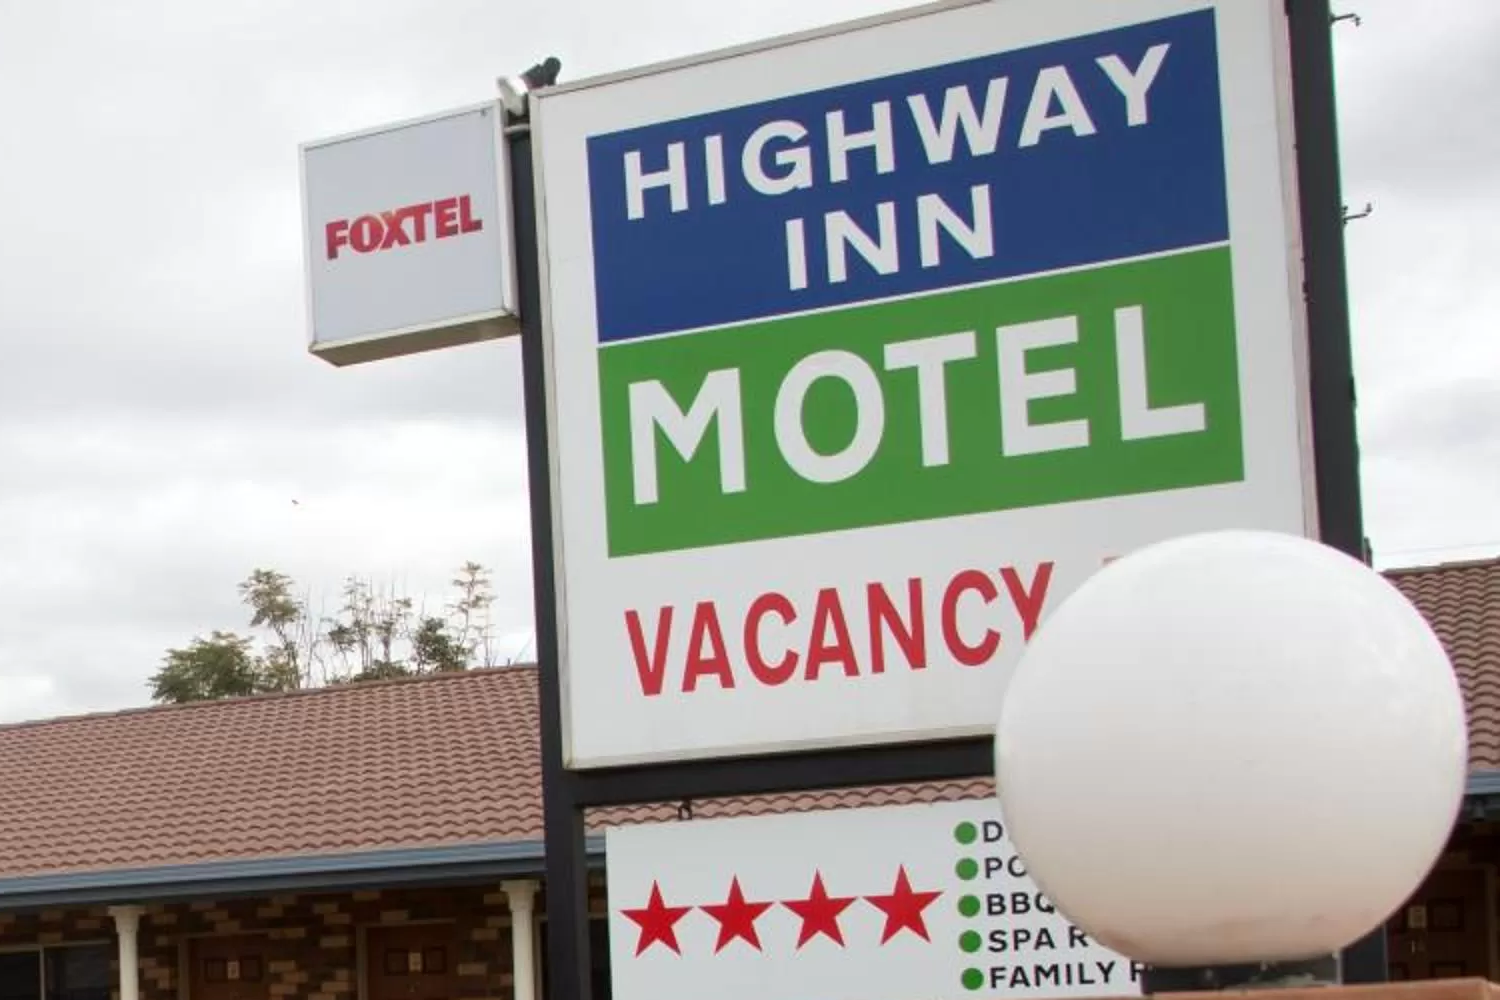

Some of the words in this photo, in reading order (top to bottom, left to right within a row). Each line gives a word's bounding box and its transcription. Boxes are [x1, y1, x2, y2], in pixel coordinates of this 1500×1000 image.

[622, 42, 1171, 221] HIGHWAY
[324, 193, 483, 261] FOXTEL
[784, 182, 995, 291] INN
[627, 304, 1208, 506] MOTEL
[623, 561, 1055, 698] VACANCY
[988, 927, 1056, 953] SPA
[989, 961, 1116, 989] FAMILY
